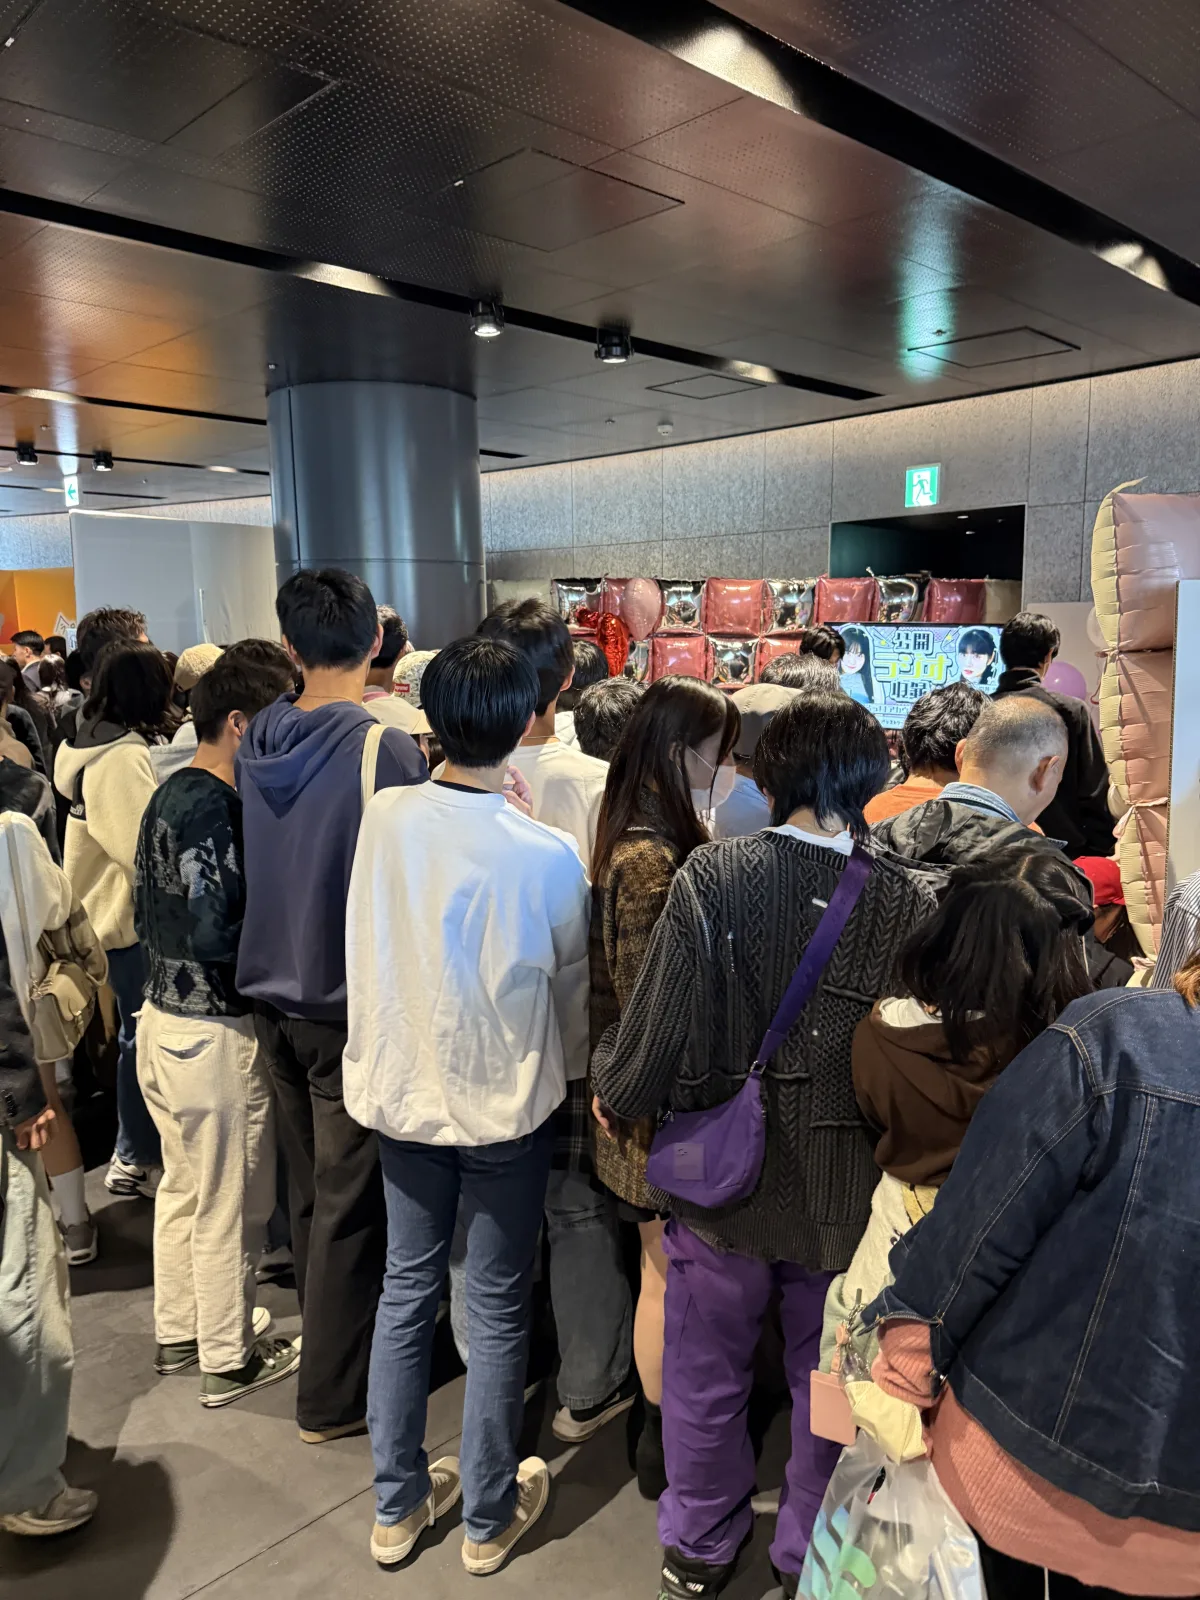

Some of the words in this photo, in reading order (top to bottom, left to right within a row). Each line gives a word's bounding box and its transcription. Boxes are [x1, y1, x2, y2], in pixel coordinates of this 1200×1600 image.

[895, 632, 930, 651] 公開
[874, 652, 950, 681] ラジオ
